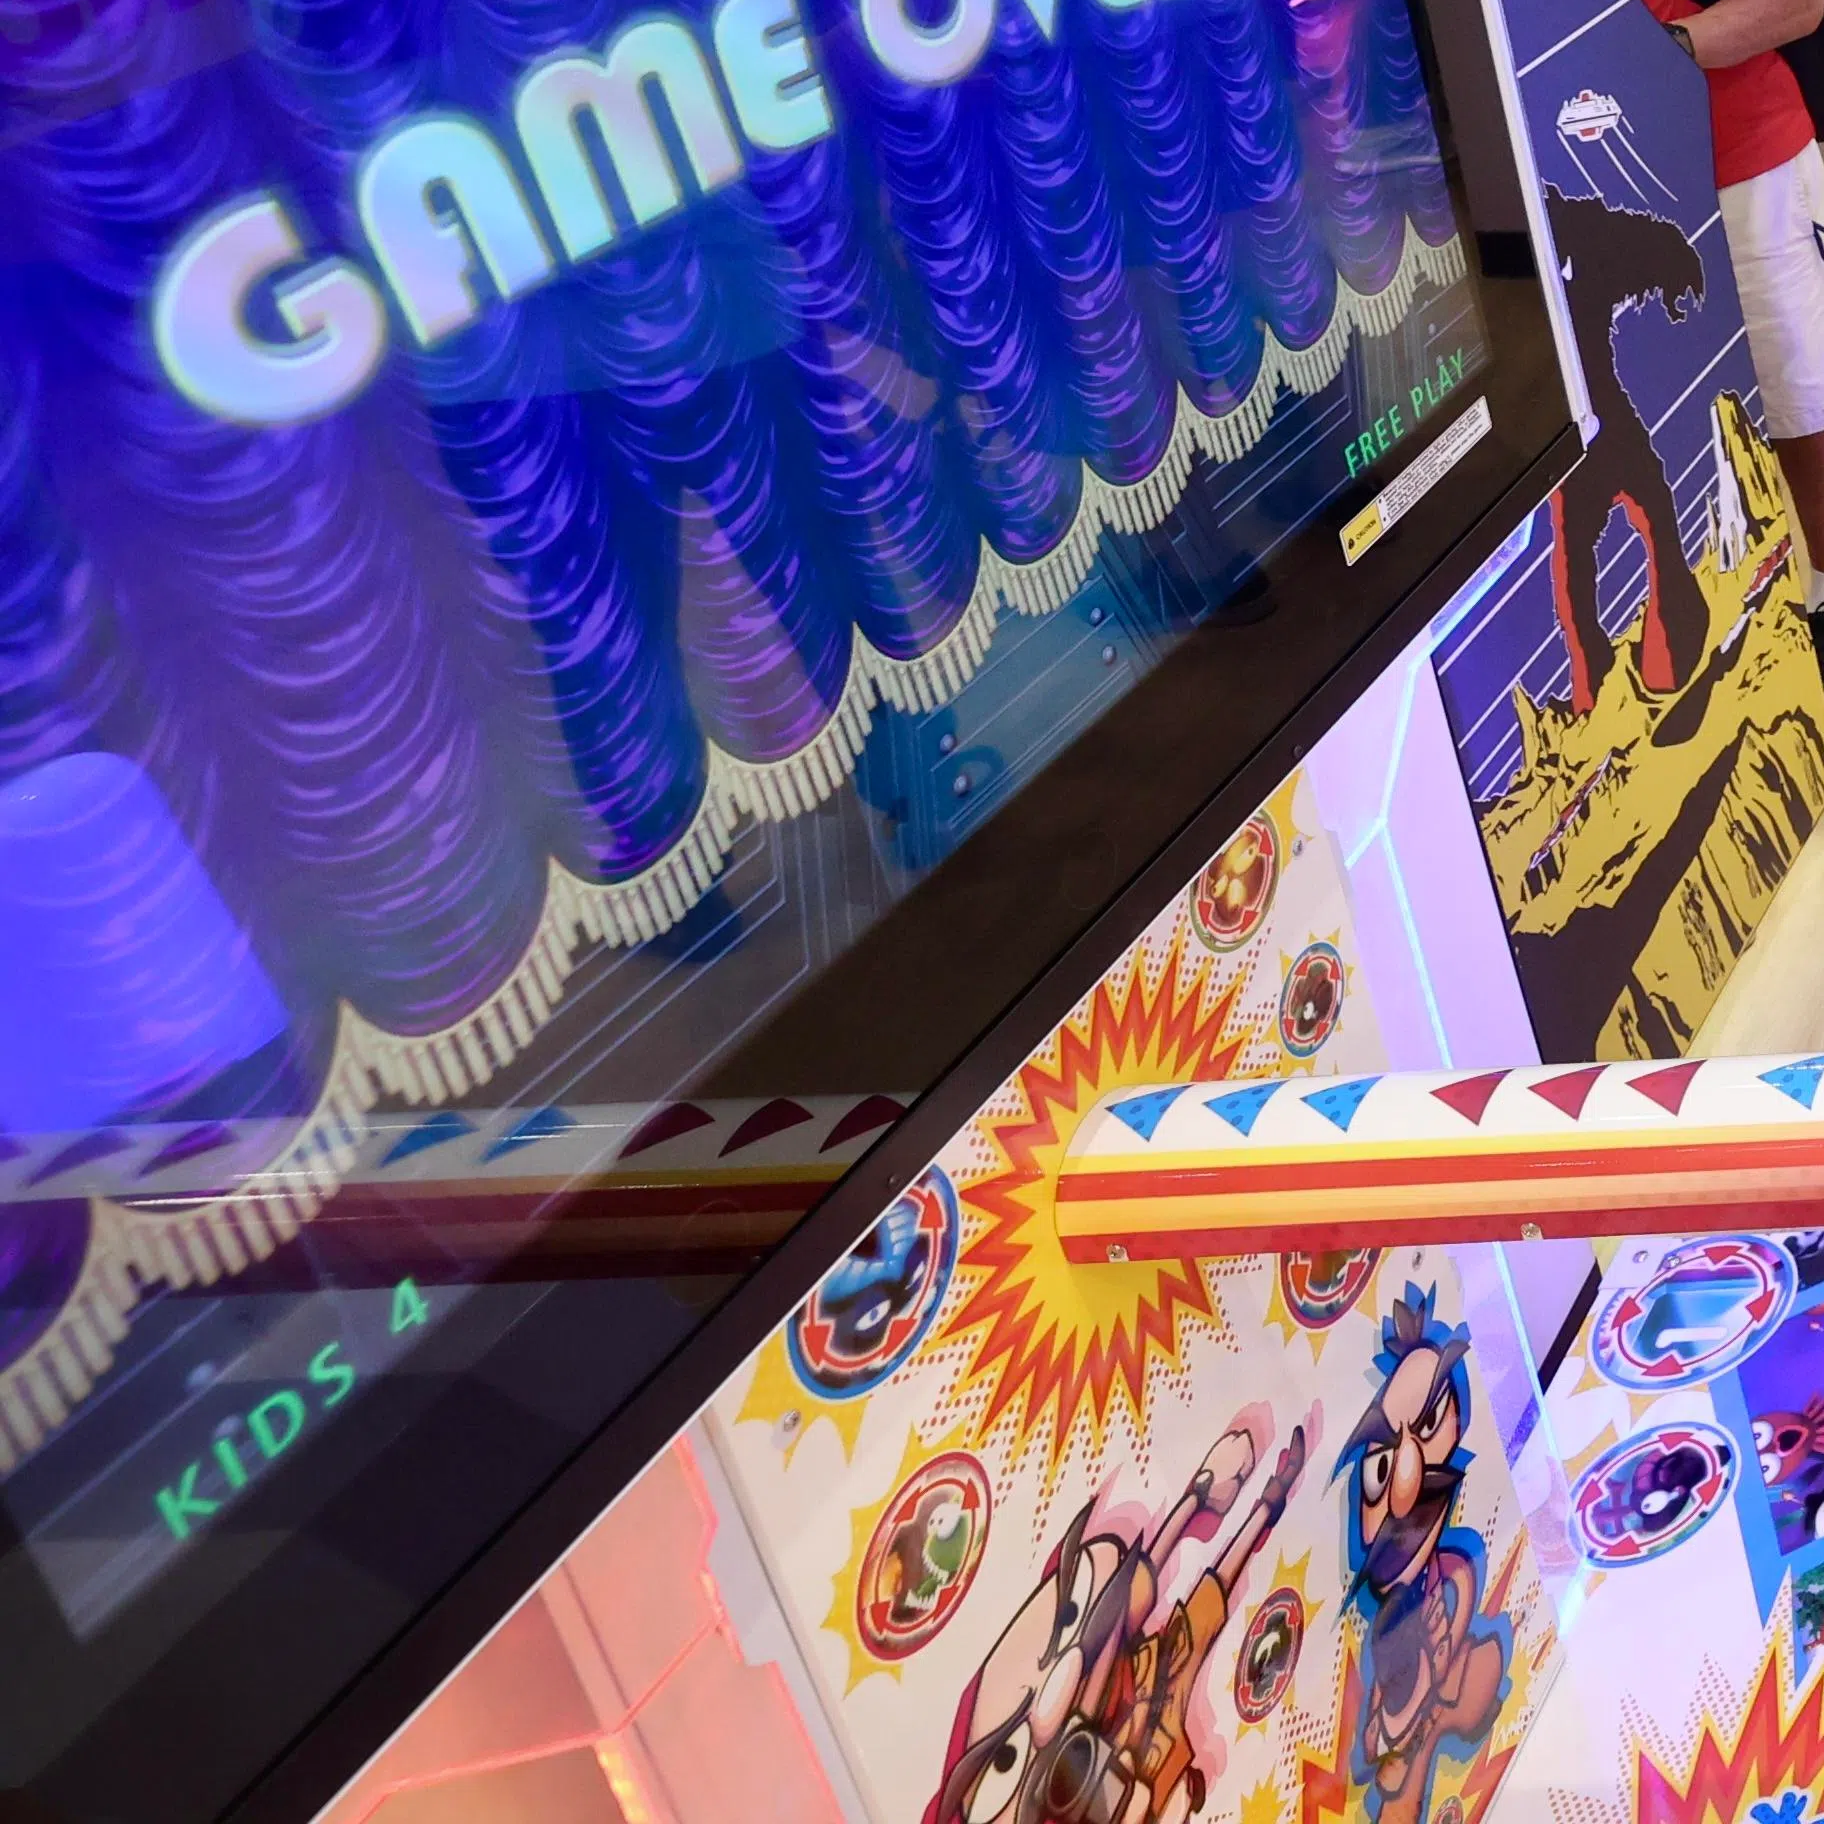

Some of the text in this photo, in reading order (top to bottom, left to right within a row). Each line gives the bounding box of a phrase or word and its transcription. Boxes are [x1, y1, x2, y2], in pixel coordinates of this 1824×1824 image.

[1344, 404, 1405, 479] FREE
[1409, 348, 1466, 419] PLAY
[154, 1277, 431, 1540] KIDS 4
